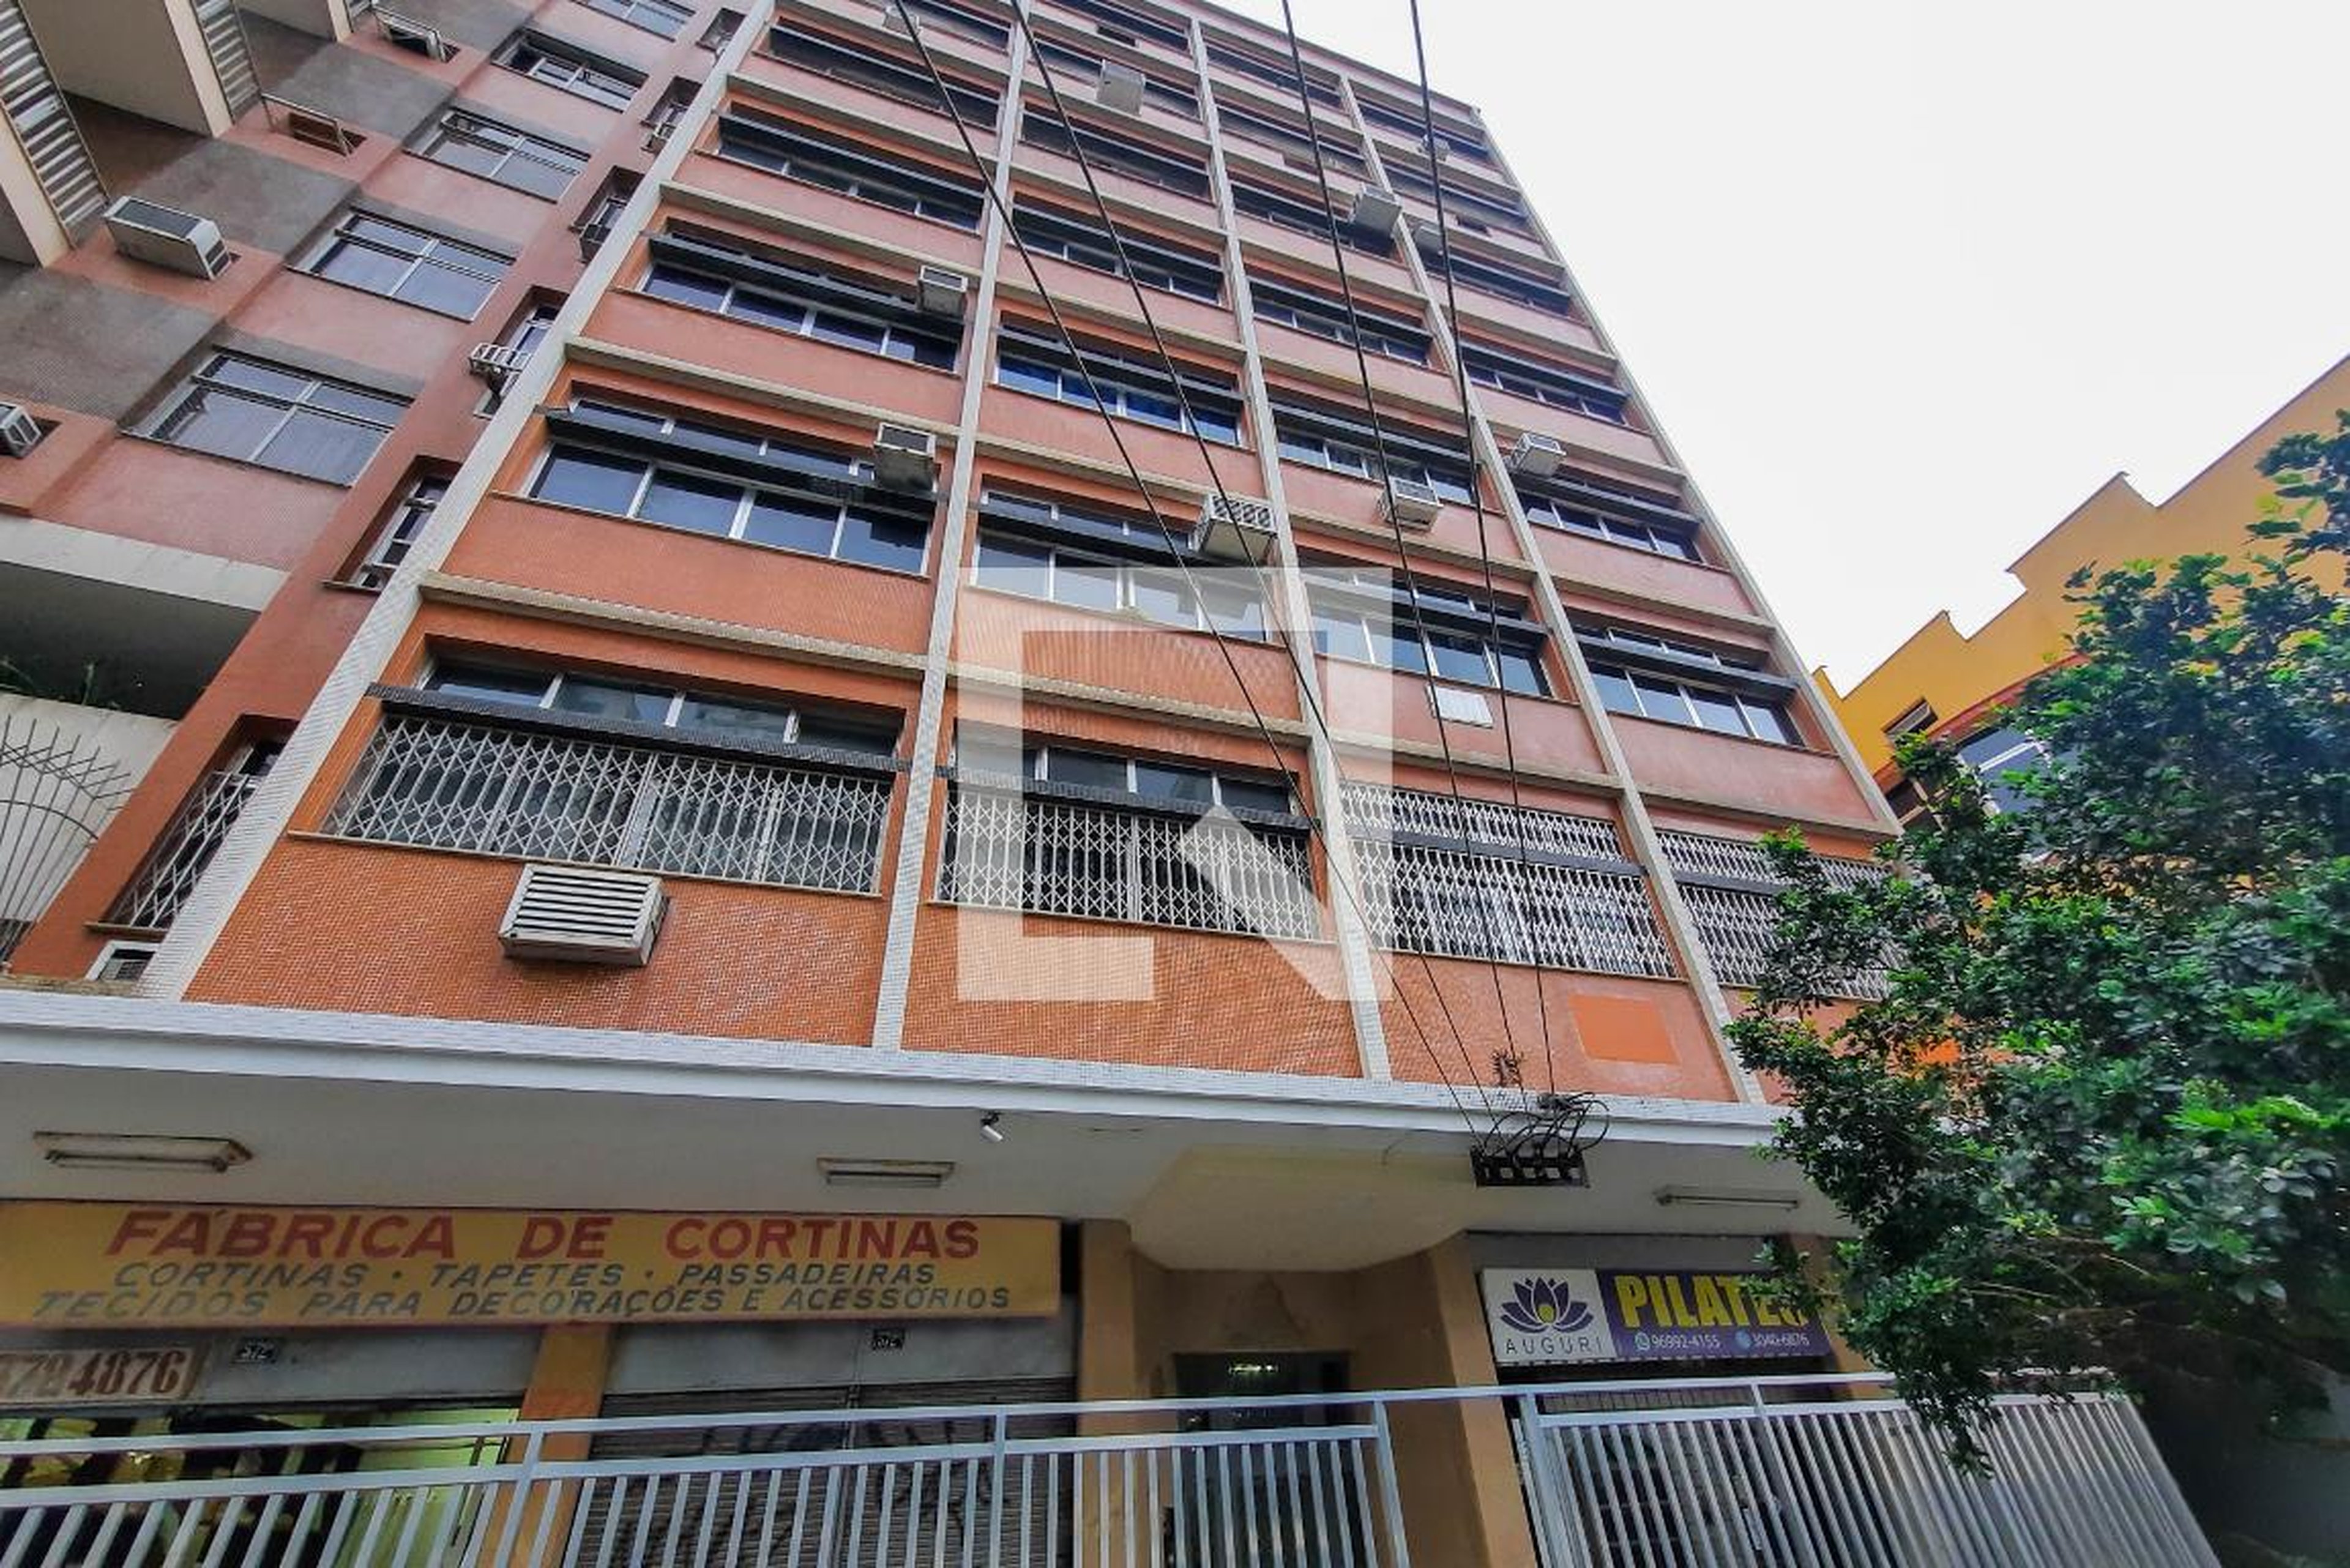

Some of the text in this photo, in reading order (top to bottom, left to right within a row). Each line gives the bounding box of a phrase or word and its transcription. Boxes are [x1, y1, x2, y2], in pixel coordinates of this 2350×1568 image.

[105, 1209, 980, 1260] FÁBRICA DE CORTINAS
[114, 1262, 936, 1289] CORTINAS TAPETES PASSADEIRAS
[34, 1291, 270, 1318] TECIDOS
[300, 1291, 421, 1317] PARA
[743, 1288, 760, 1311] E
[783, 1286, 1011, 1310] ACESSÓRIOS
[1505, 1336, 1603, 1355] AUGURI
